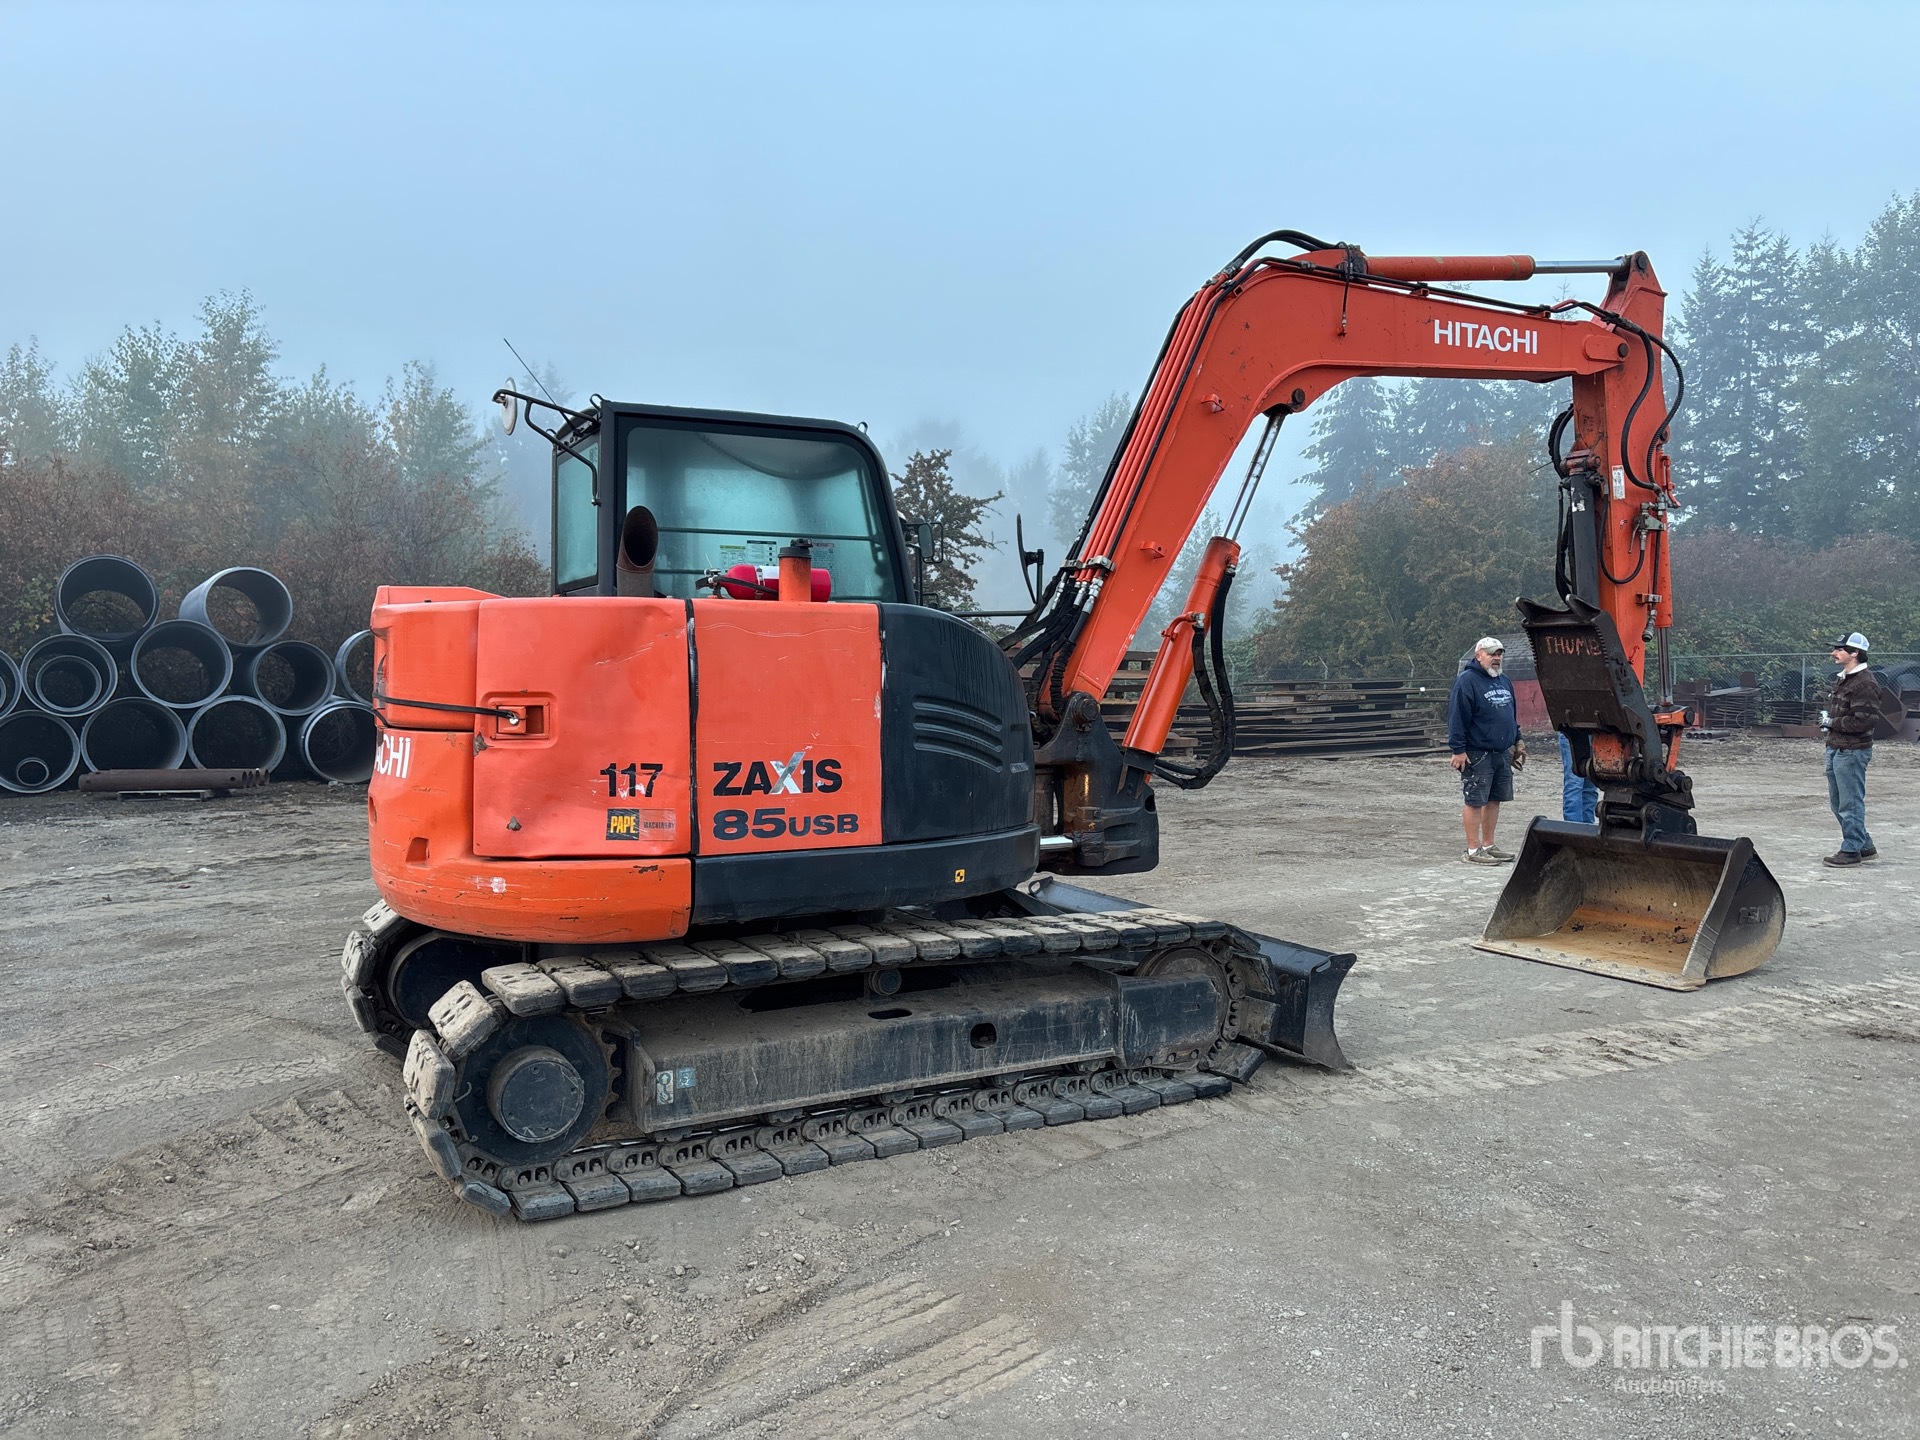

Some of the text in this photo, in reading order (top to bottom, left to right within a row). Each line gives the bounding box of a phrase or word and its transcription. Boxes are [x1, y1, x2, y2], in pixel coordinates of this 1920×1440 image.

[1434, 319, 1538, 355] HITACHI
[600, 762, 663, 798] 117
[713, 751, 843, 797] ZAXIS
